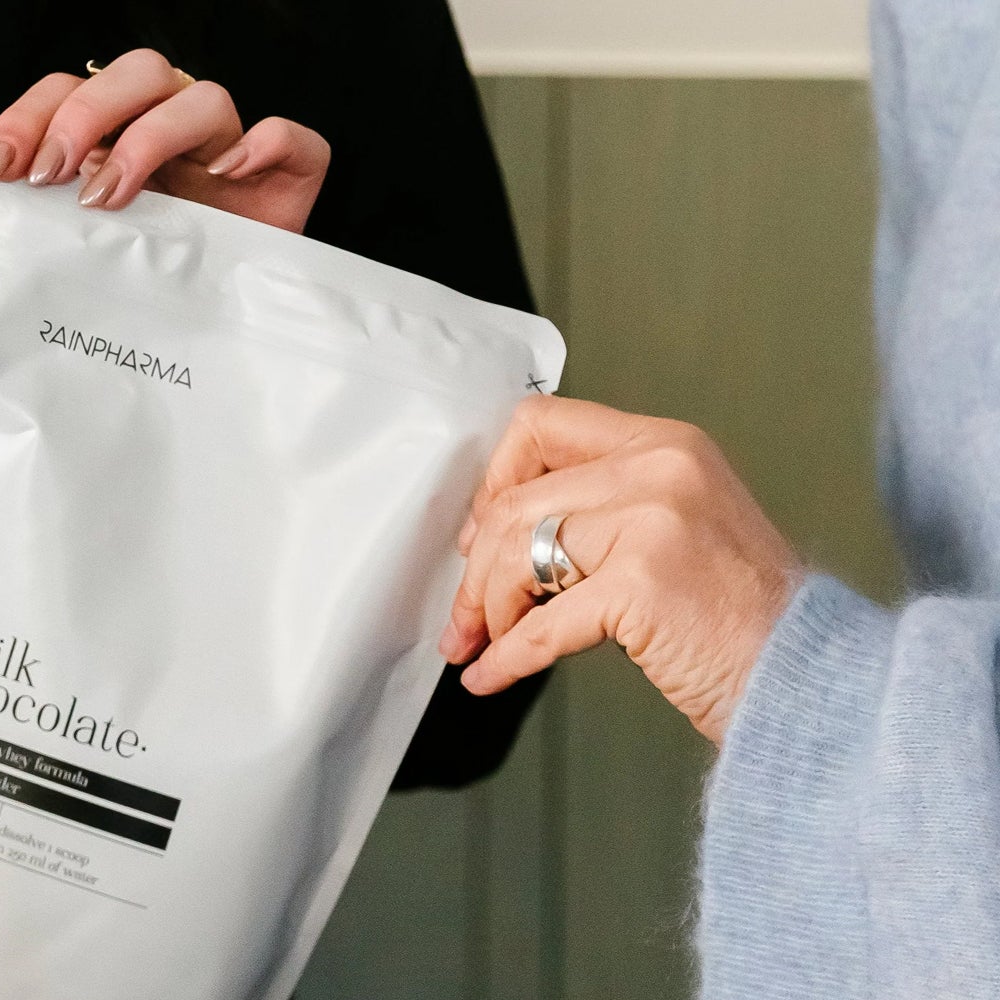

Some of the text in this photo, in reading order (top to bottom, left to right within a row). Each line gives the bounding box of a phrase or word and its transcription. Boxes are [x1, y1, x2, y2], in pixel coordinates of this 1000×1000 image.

[40, 320, 192, 389] RAINPHARMA
[33, 756, 89, 788] formula
[55, 847, 90, 868] scoop
[48, 861, 62, 872] of
[63, 867, 99, 885] water
